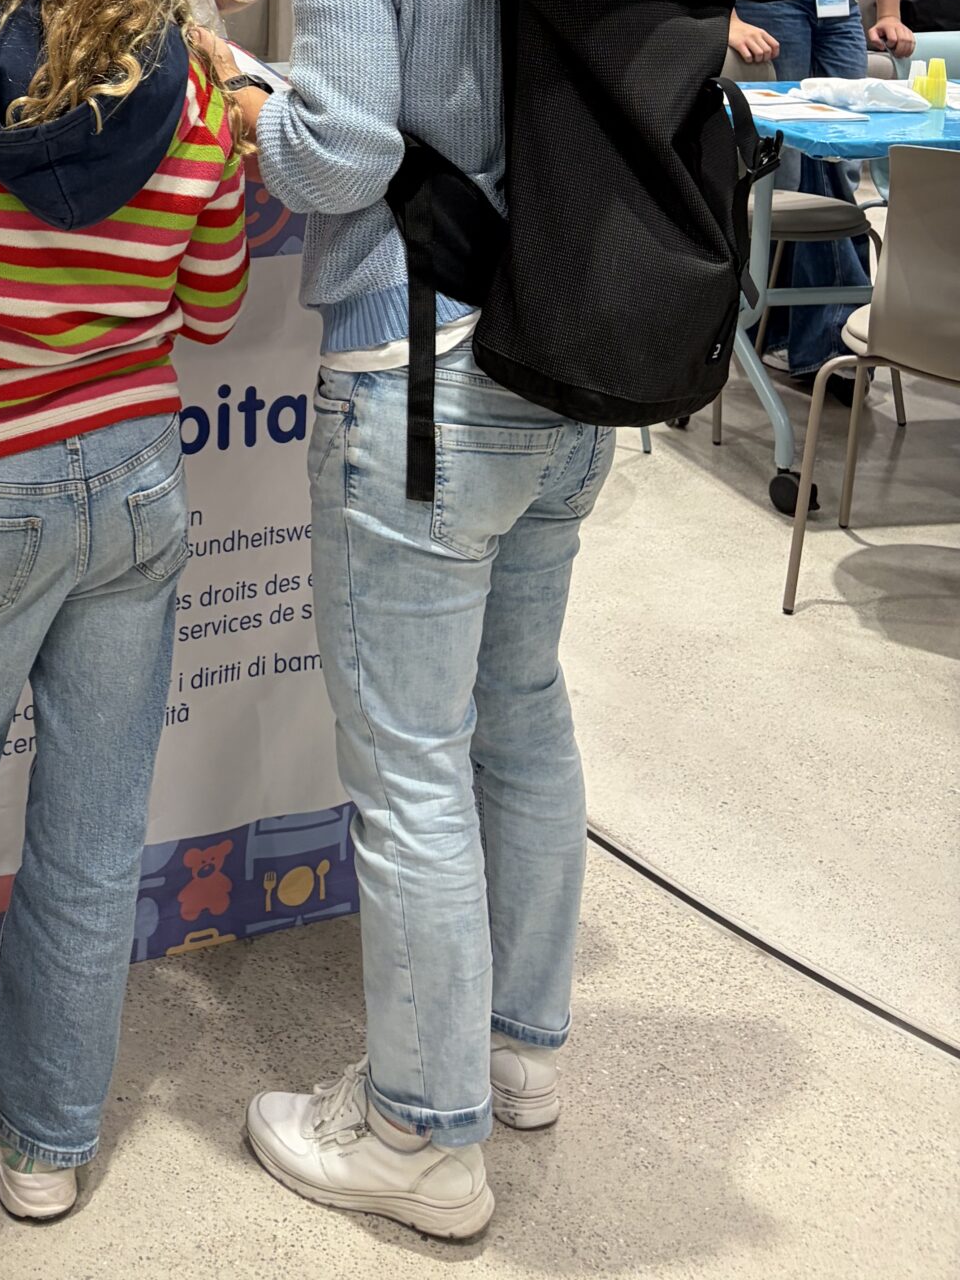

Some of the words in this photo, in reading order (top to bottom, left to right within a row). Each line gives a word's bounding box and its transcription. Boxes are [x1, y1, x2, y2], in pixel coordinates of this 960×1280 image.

[179, 383, 308, 455] pita
[188, 524, 312, 558] sundheitswe
[200, 581, 258, 608] droits
[265, 573, 301, 596] des
[178, 612, 263, 642] services
[269, 603, 295, 625] de
[190, 661, 241, 690] diritti
[247, 655, 266, 678] di
[273, 652, 323, 674] bam
[165, 702, 190, 726] ità
